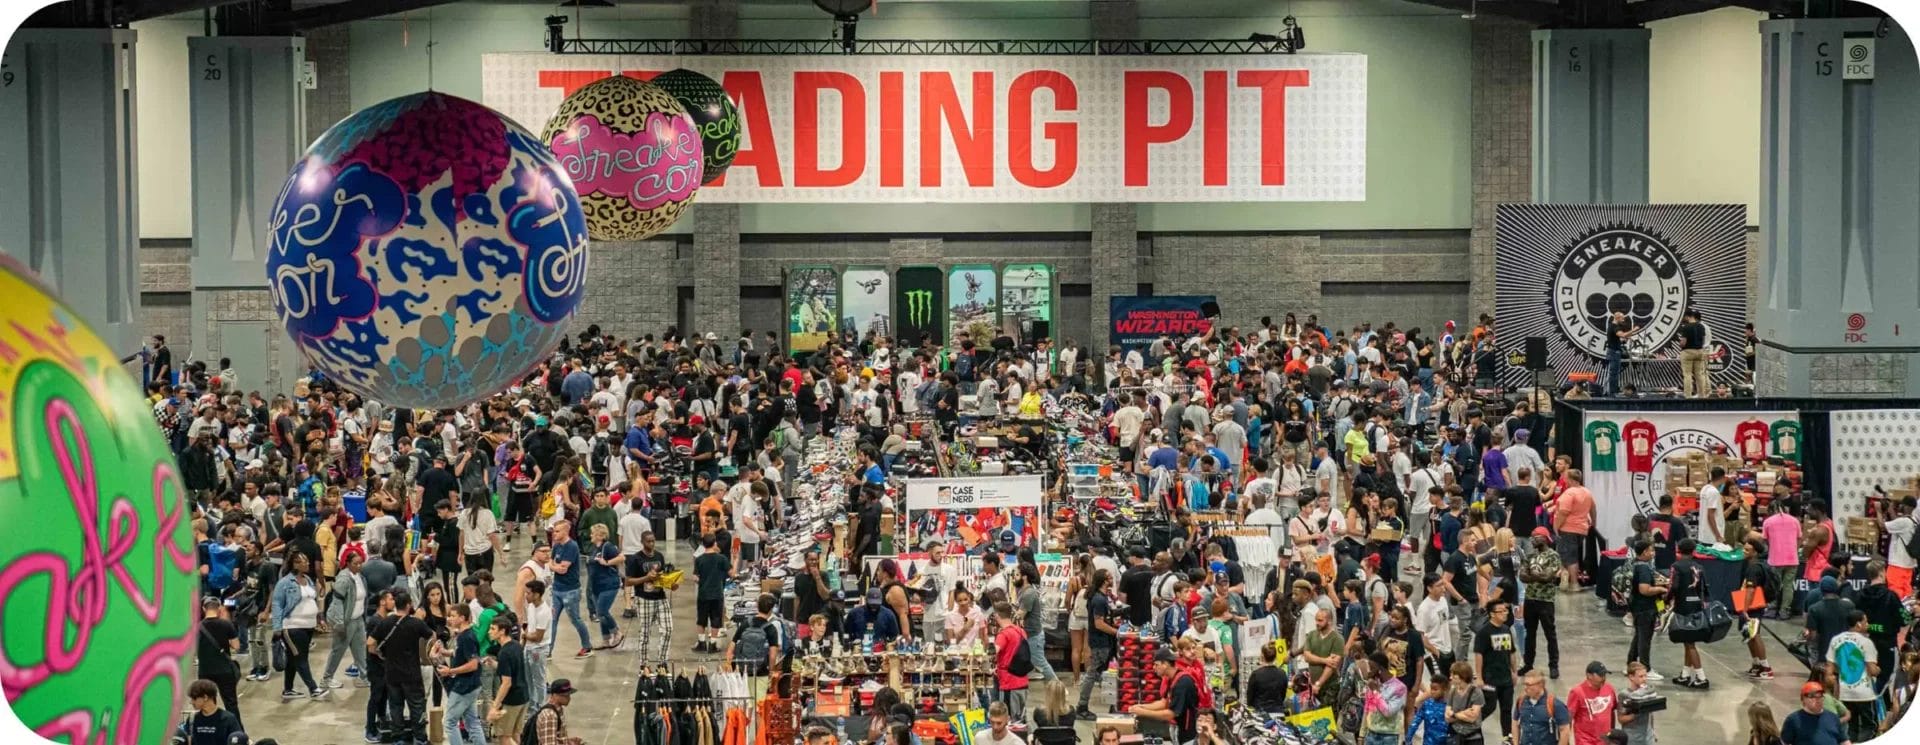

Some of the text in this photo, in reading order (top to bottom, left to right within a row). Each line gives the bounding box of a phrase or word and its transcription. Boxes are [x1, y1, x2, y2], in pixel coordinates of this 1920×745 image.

[1568, 46, 1579, 58] C
[1817, 42, 1828, 57] C
[206, 54, 216, 66] C
[1568, 60, 1581, 72] 16
[204, 68, 221, 80] 20
[1815, 60, 1833, 76] 15
[1847, 64, 1871, 74] FDC
[539, 70, 1309, 188] ADING PIT
[1573, 237, 1669, 269] SNEAKER
[1128, 311, 1199, 319] WASHINGTON
[1561, 285, 1681, 351] CONVEATIONS
[1115, 319, 1212, 334] WIZARDS
[1844, 333, 1868, 343] FDC
[952, 486, 974, 495] CASE
[1652, 479, 1662, 490] EST
[952, 495, 974, 504] NERD
